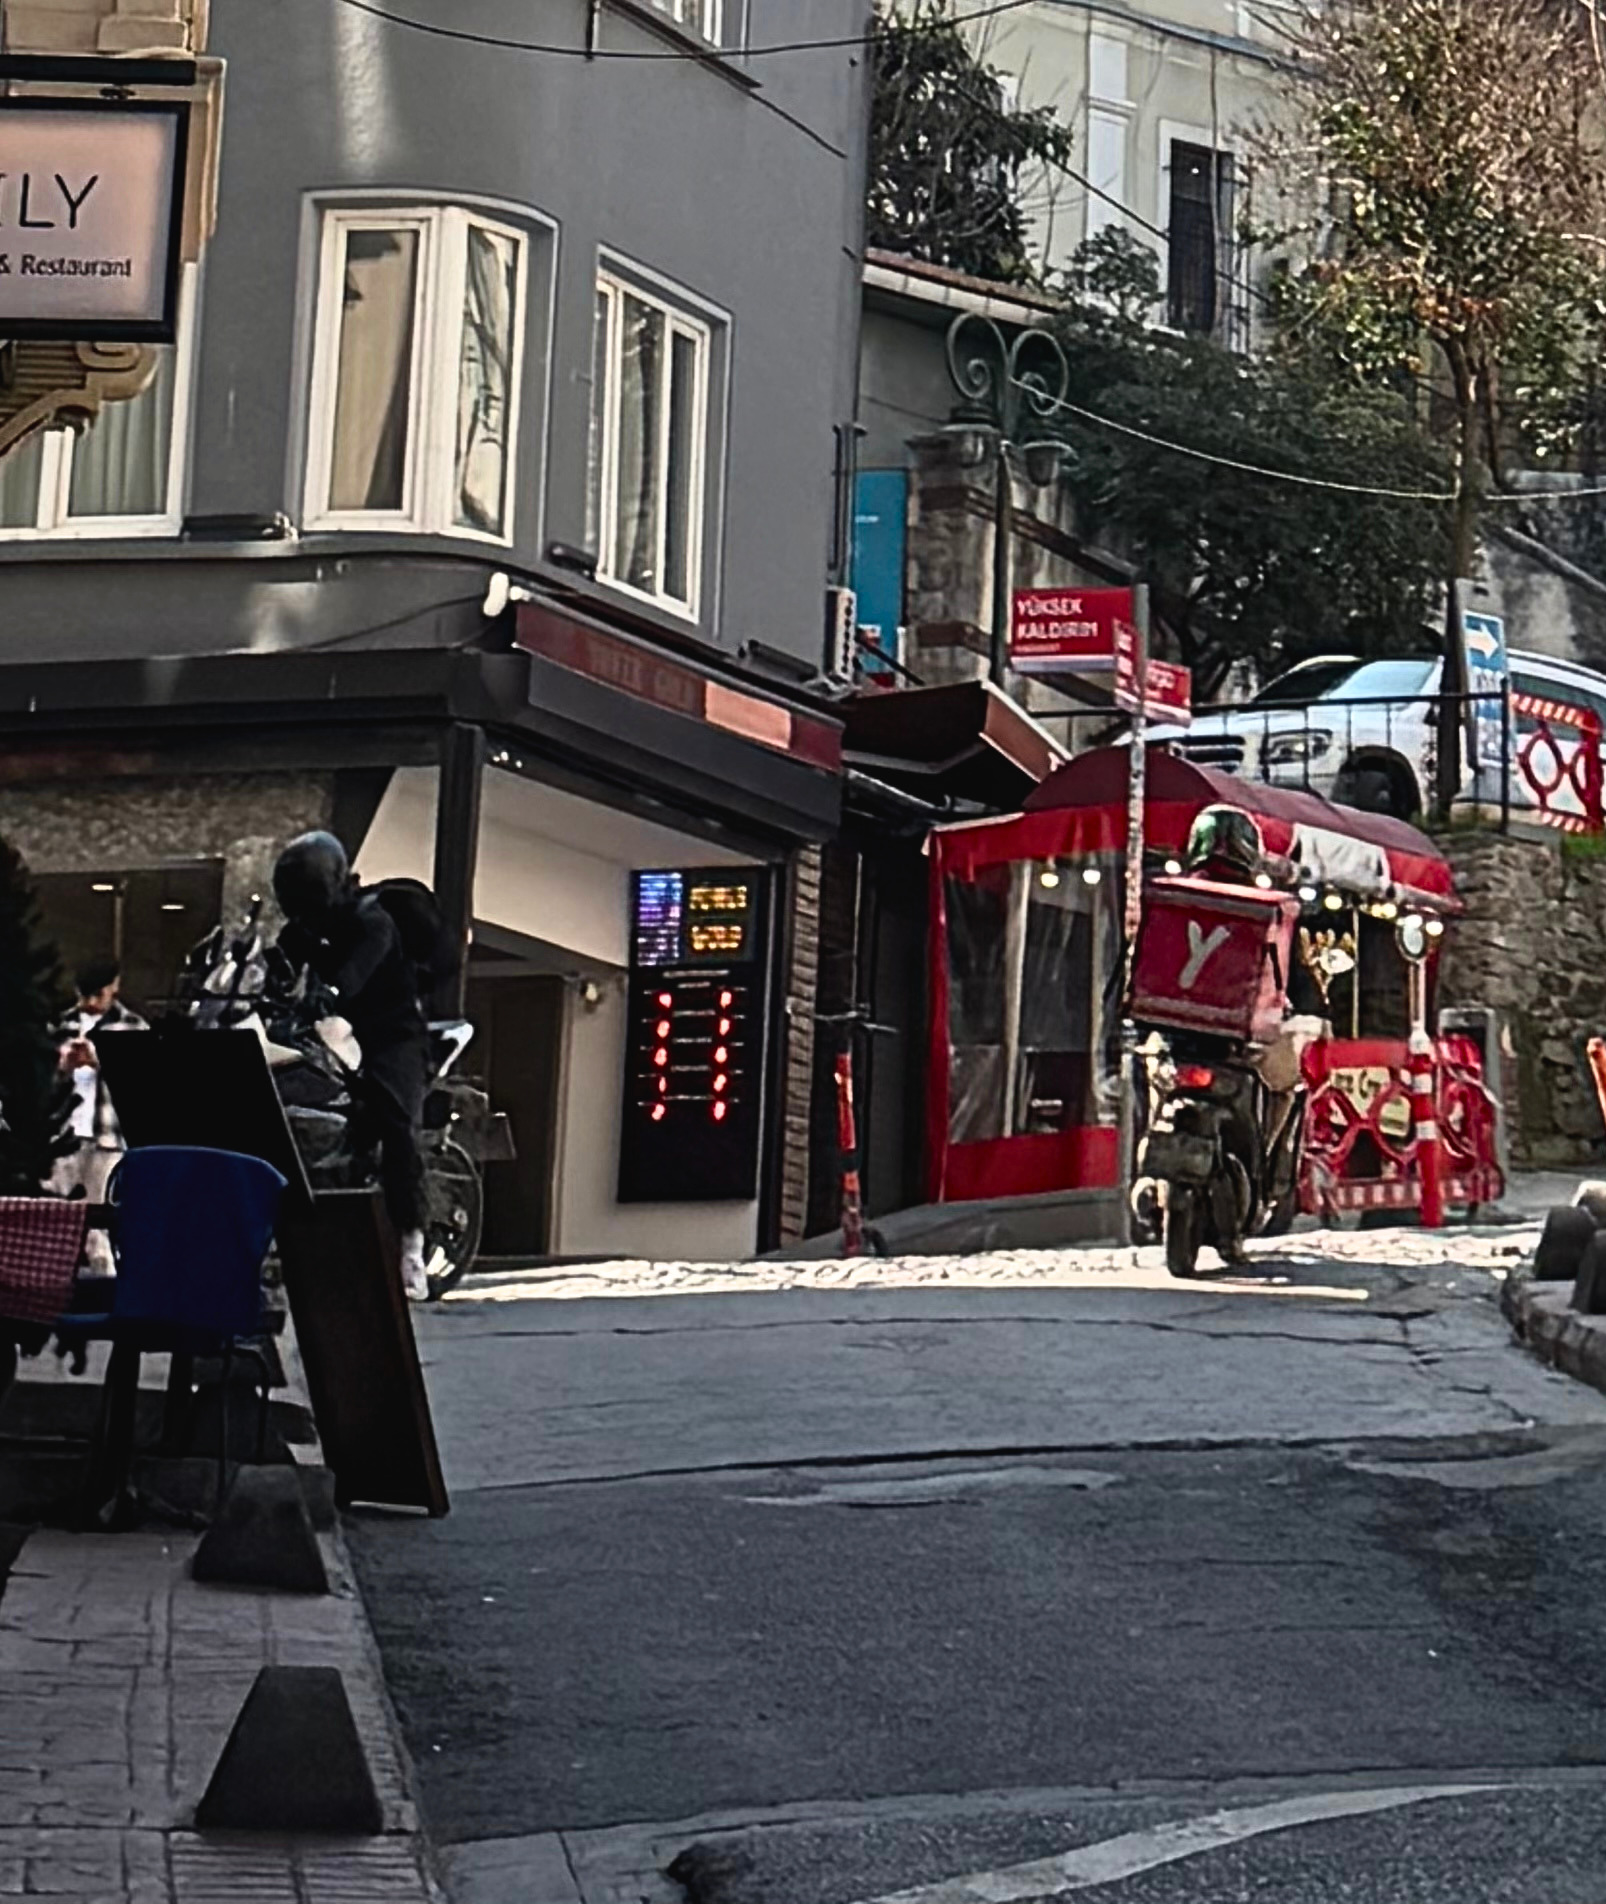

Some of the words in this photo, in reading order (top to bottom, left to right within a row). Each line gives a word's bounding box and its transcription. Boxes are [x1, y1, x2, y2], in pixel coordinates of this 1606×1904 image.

[0, 173, 98, 229] LY
[20, 254, 132, 278] Restaurant
[1178, 920, 1231, 990] Y
